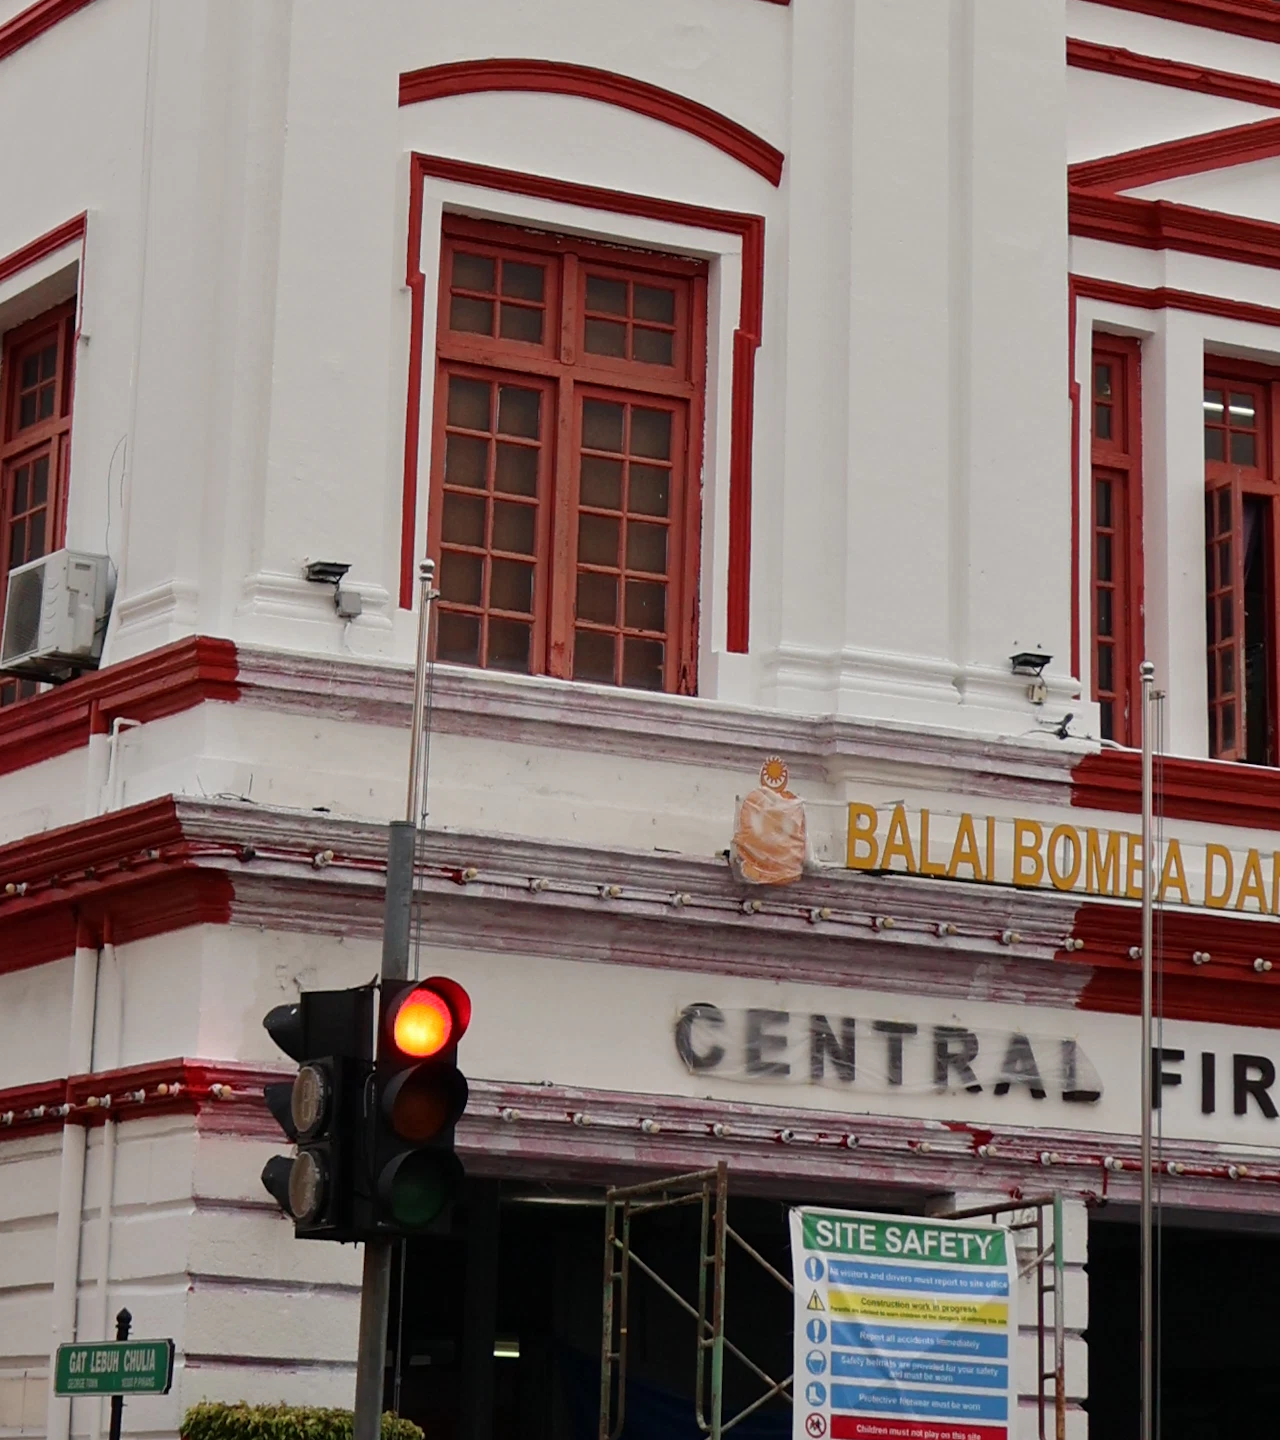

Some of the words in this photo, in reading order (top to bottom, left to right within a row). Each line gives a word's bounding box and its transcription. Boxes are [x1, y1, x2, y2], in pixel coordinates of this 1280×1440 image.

[846, 802, 995, 882] BALAI
[1013, 818, 1190, 905] BOMBA
[675, 1002, 1101, 1102] CENTRAL
[816, 1220, 876, 1251] SITE
[885, 1227, 992, 1260] SAFETY
[840, 1269, 868, 1279] visitors
[870, 1272, 884, 1281] and
[886, 1273, 912, 1283] drivers
[914, 1275, 933, 1285] must
[935, 1277, 958, 1287] report
[960, 1279, 968, 1287] to
[969, 1280, 983, 1288] site
[985, 1280, 1008, 1289] office
[861, 1298, 910, 1309] Construction
[911, 1302, 930, 1311] work
[932, 1303, 939, 1311] in
[941, 1305, 977, 1314] progress
[860, 1331, 884, 1342] Report
[886, 1334, 895, 1342] all
[897, 1335, 934, 1345] accidents
[69, 1351, 87, 1373] GAT
[90, 1350, 120, 1373] LEBUH
[124, 1348, 155, 1372] CHULIA
[923, 1372, 933, 1380] be
[958, 1366, 974, 1375] your
[976, 1367, 998, 1377] safety
[859, 1393, 897, 1404] Protective
[951, 1400, 960, 1409] be
[962, 1403, 980, 1411] worn
[856, 1424, 887, 1435] Children
[889, 1427, 909, 1437] must
[911, 1428, 923, 1437] not
[924, 1429, 939, 1440] play
[952, 1431, 966, 1440] this
